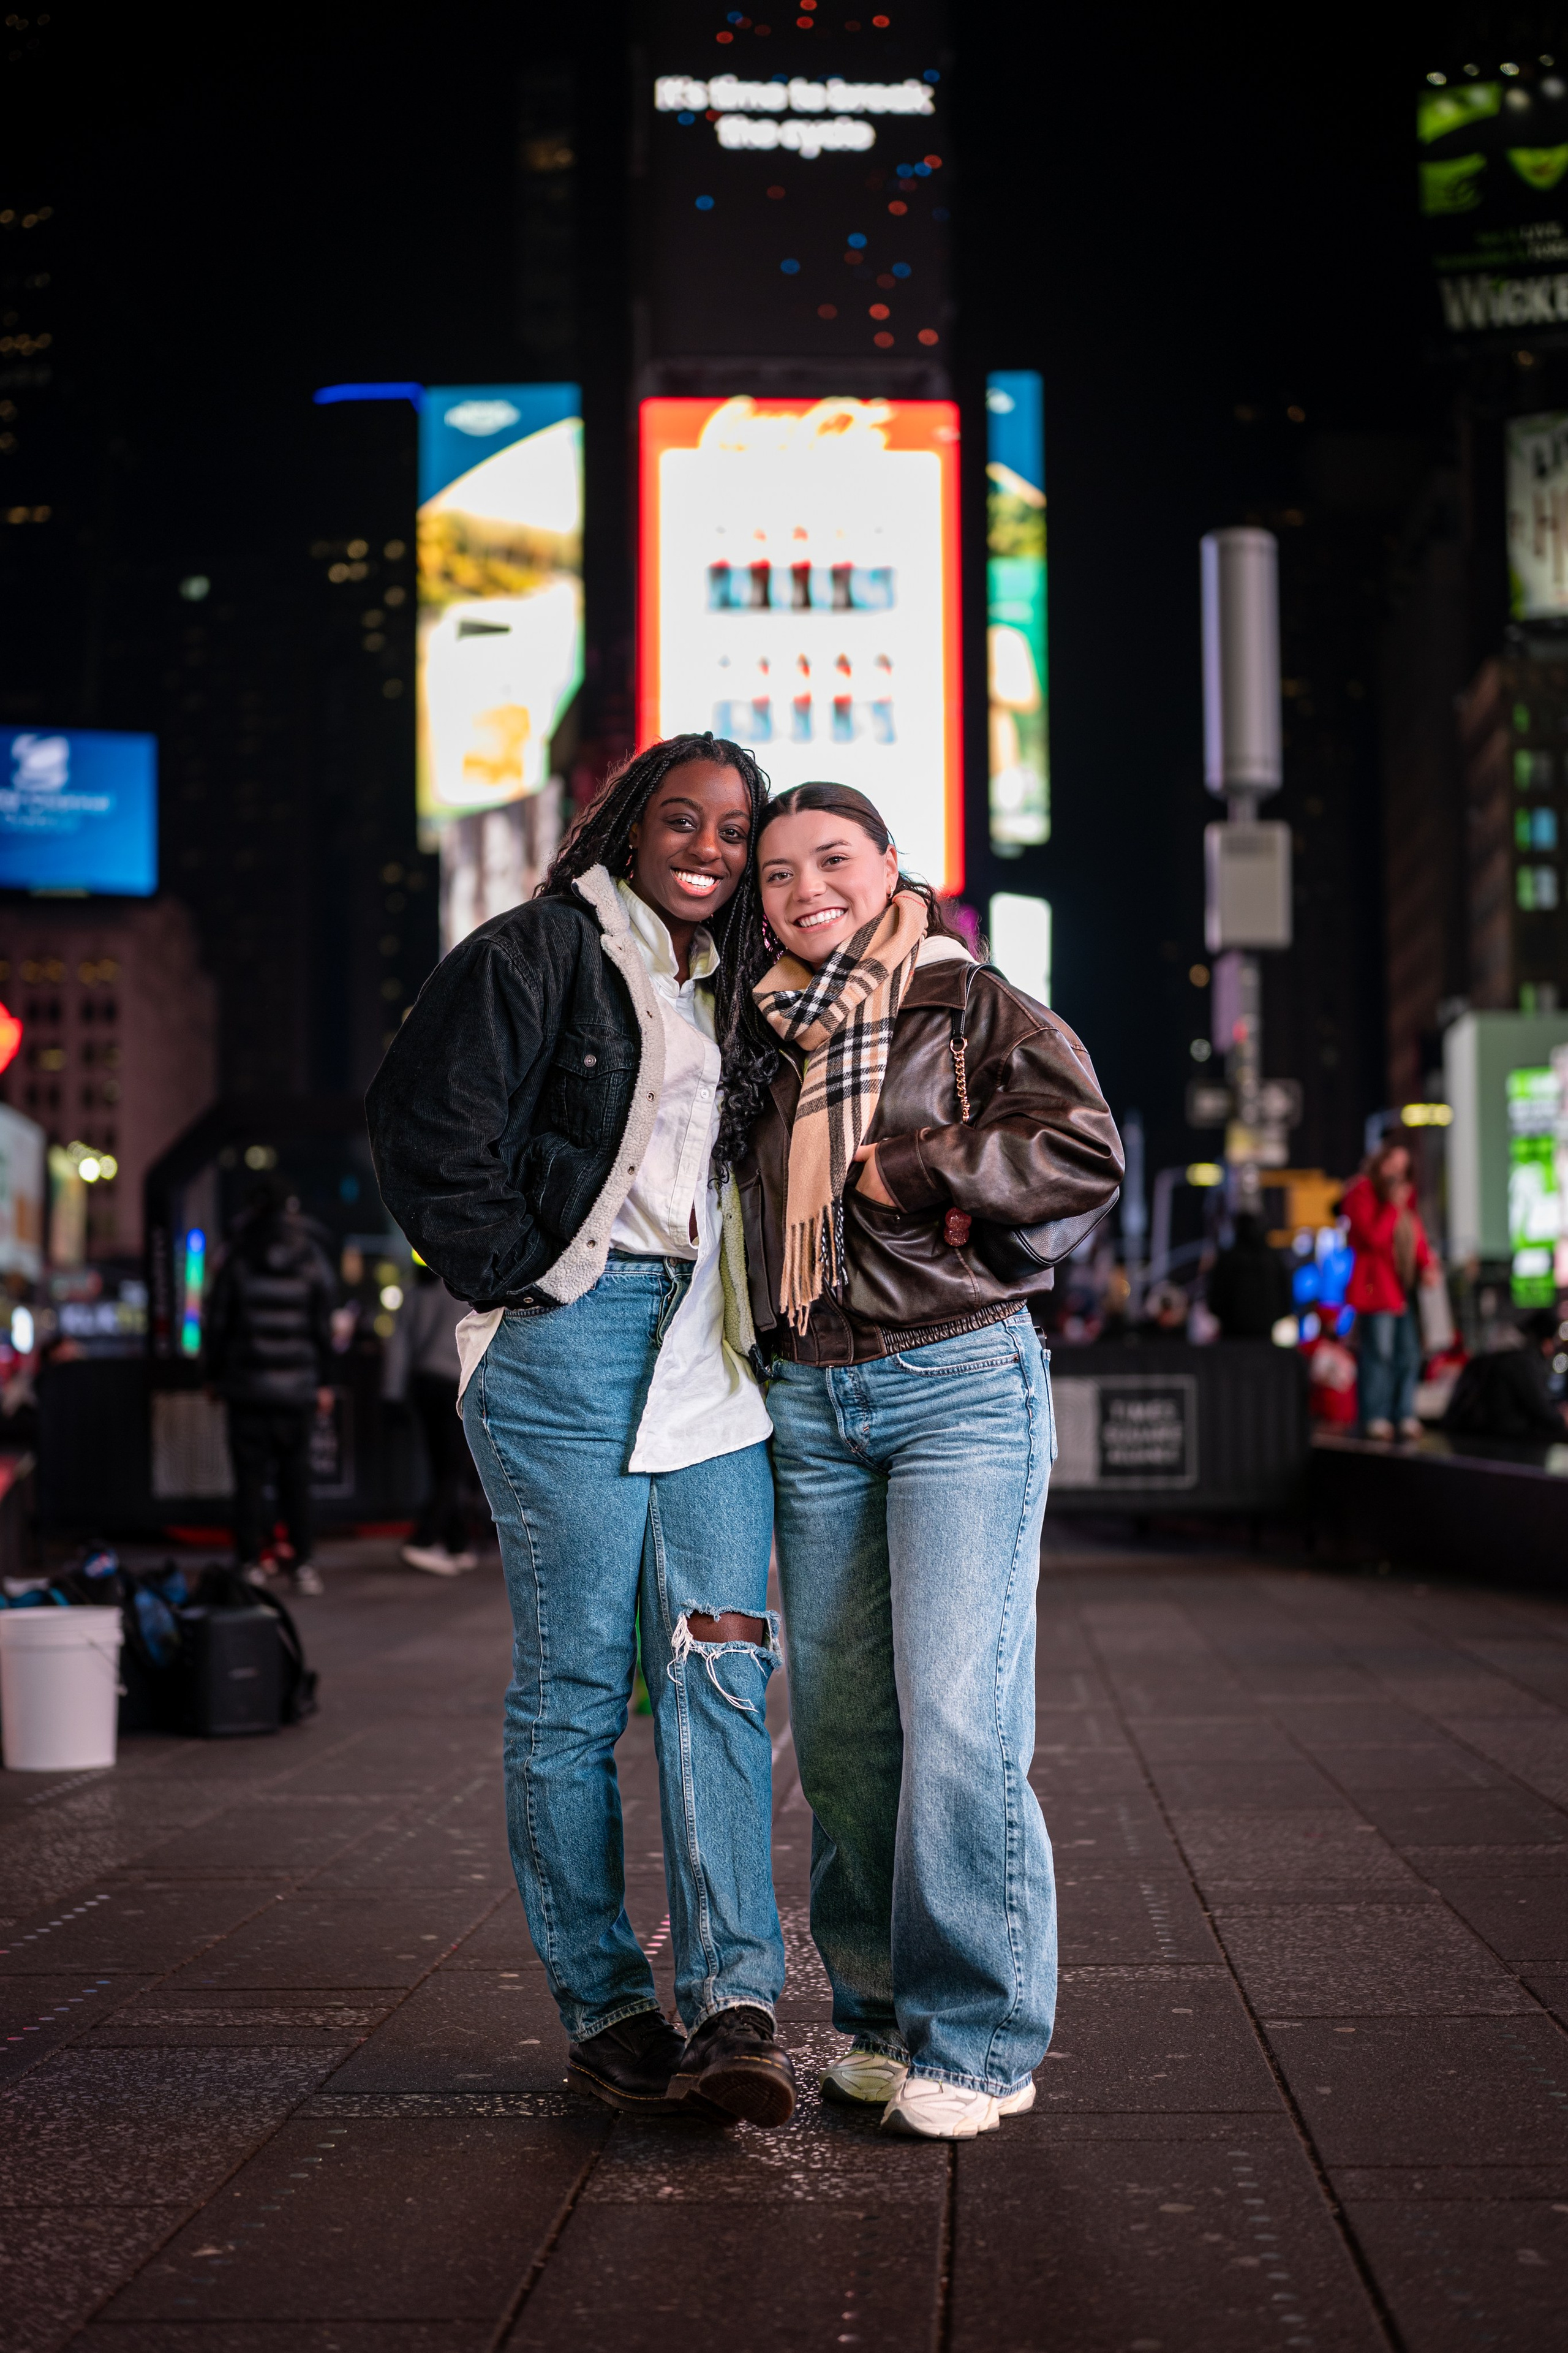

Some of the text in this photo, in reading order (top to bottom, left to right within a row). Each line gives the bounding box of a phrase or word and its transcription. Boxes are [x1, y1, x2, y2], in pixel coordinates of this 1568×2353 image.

[709, 74, 788, 111] time
[789, 78, 827, 112] to
[715, 114, 780, 150] the
